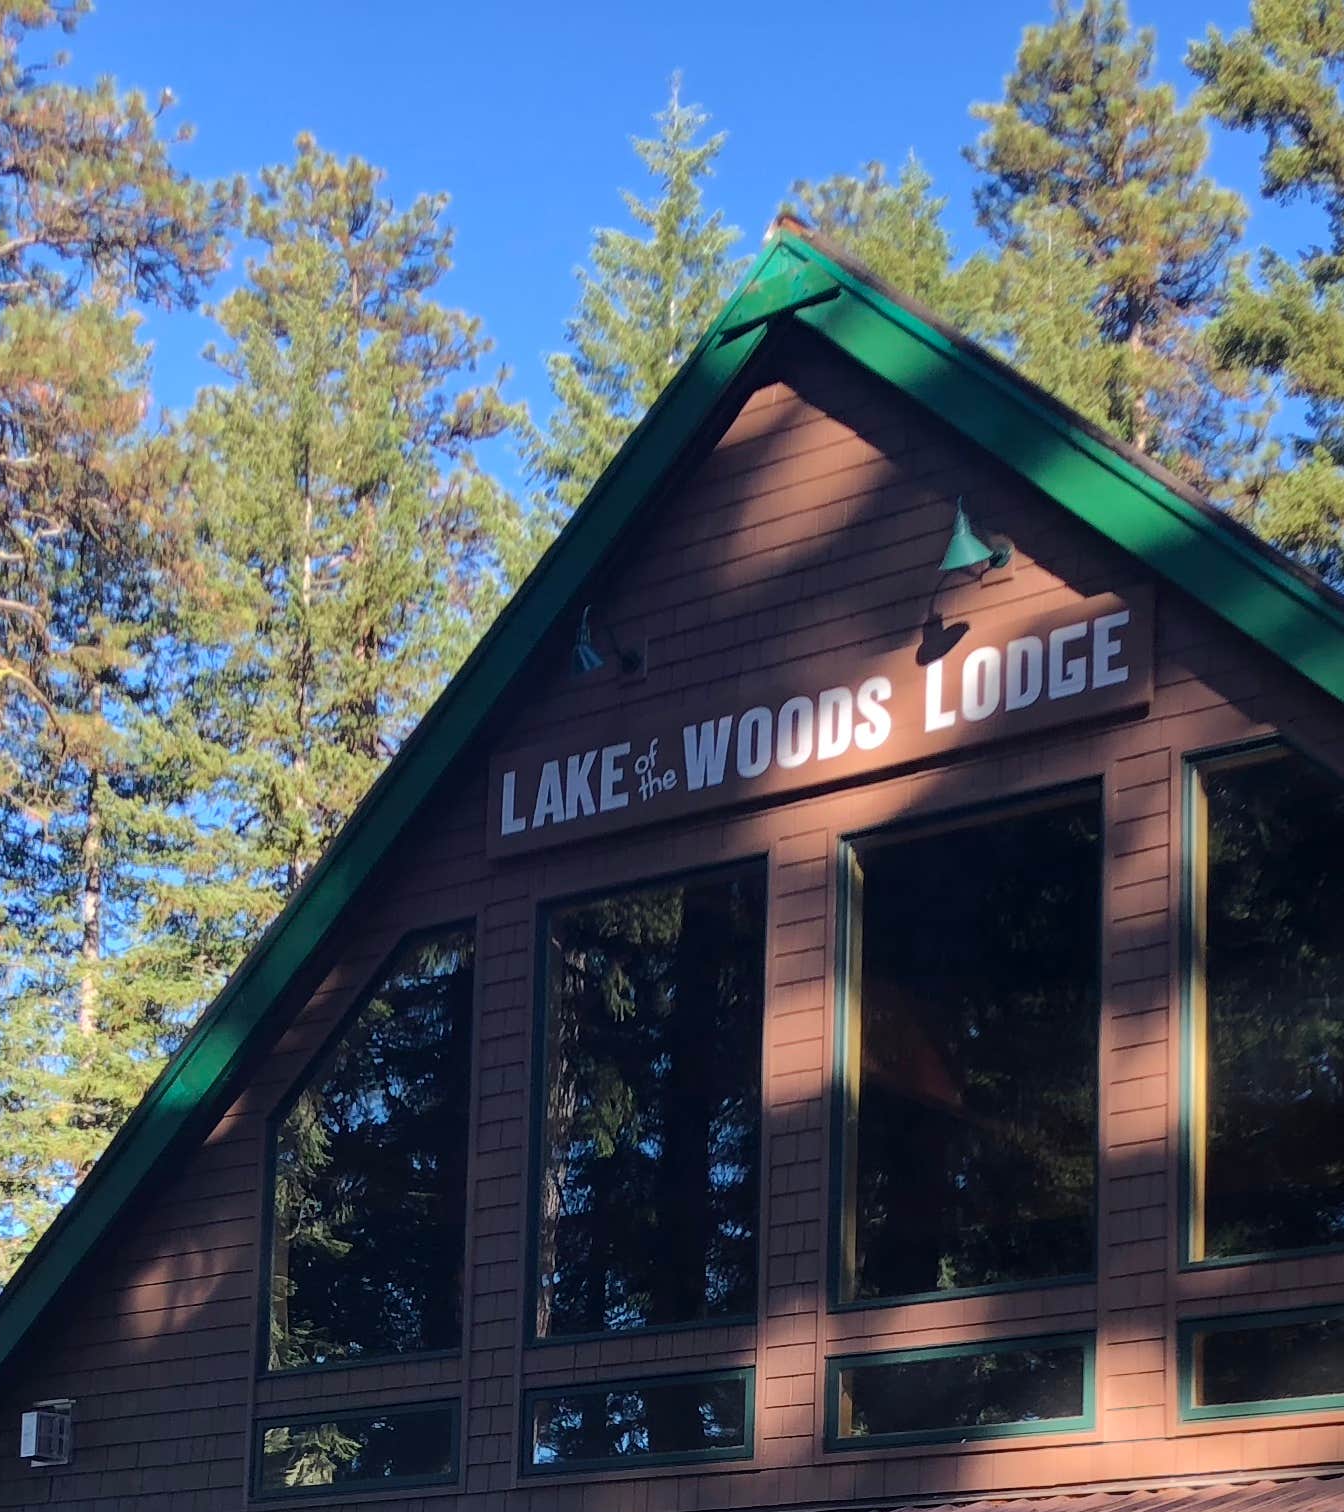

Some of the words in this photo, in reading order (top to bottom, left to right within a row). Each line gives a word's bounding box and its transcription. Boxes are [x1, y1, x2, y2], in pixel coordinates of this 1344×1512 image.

[922, 609, 1131, 734] LODGE
[633, 737, 659, 772] of
[682, 675, 892, 792] WOODS
[500, 741, 632, 836] LAKE
[637, 765, 678, 802] the
